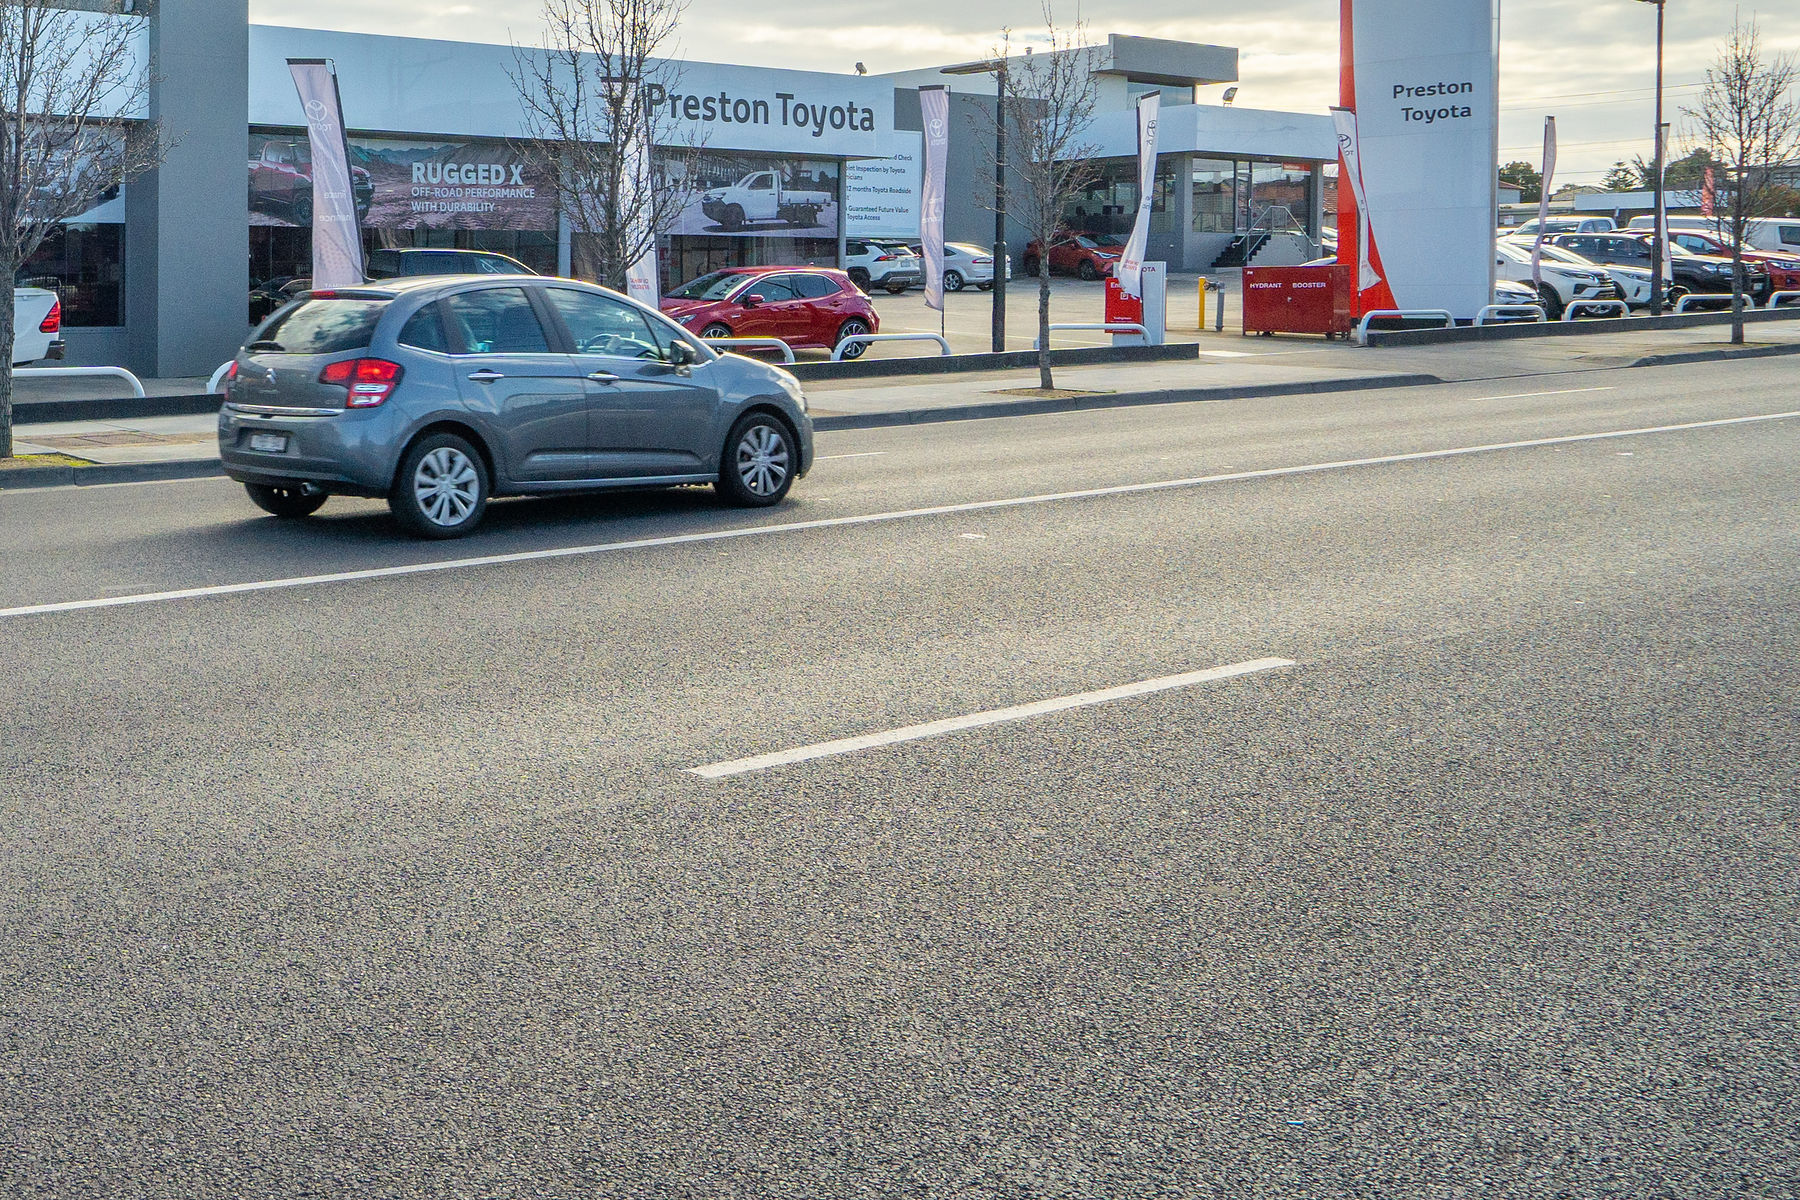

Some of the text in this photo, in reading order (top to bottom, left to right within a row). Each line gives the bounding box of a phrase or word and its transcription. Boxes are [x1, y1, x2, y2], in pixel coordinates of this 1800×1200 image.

[1392, 82, 1473, 99] Preston
[647, 83, 875, 137] Preston Toyota
[1401, 105, 1472, 124] Toyota
[412, 162, 524, 185] RUGGED X
[890, 166, 906, 174] Toyota
[411, 186, 535, 198] OFF-ROAD PERFORMANCE
[873, 186, 889, 194] Toyota
[411, 201, 496, 212] WITH DURABILITY
